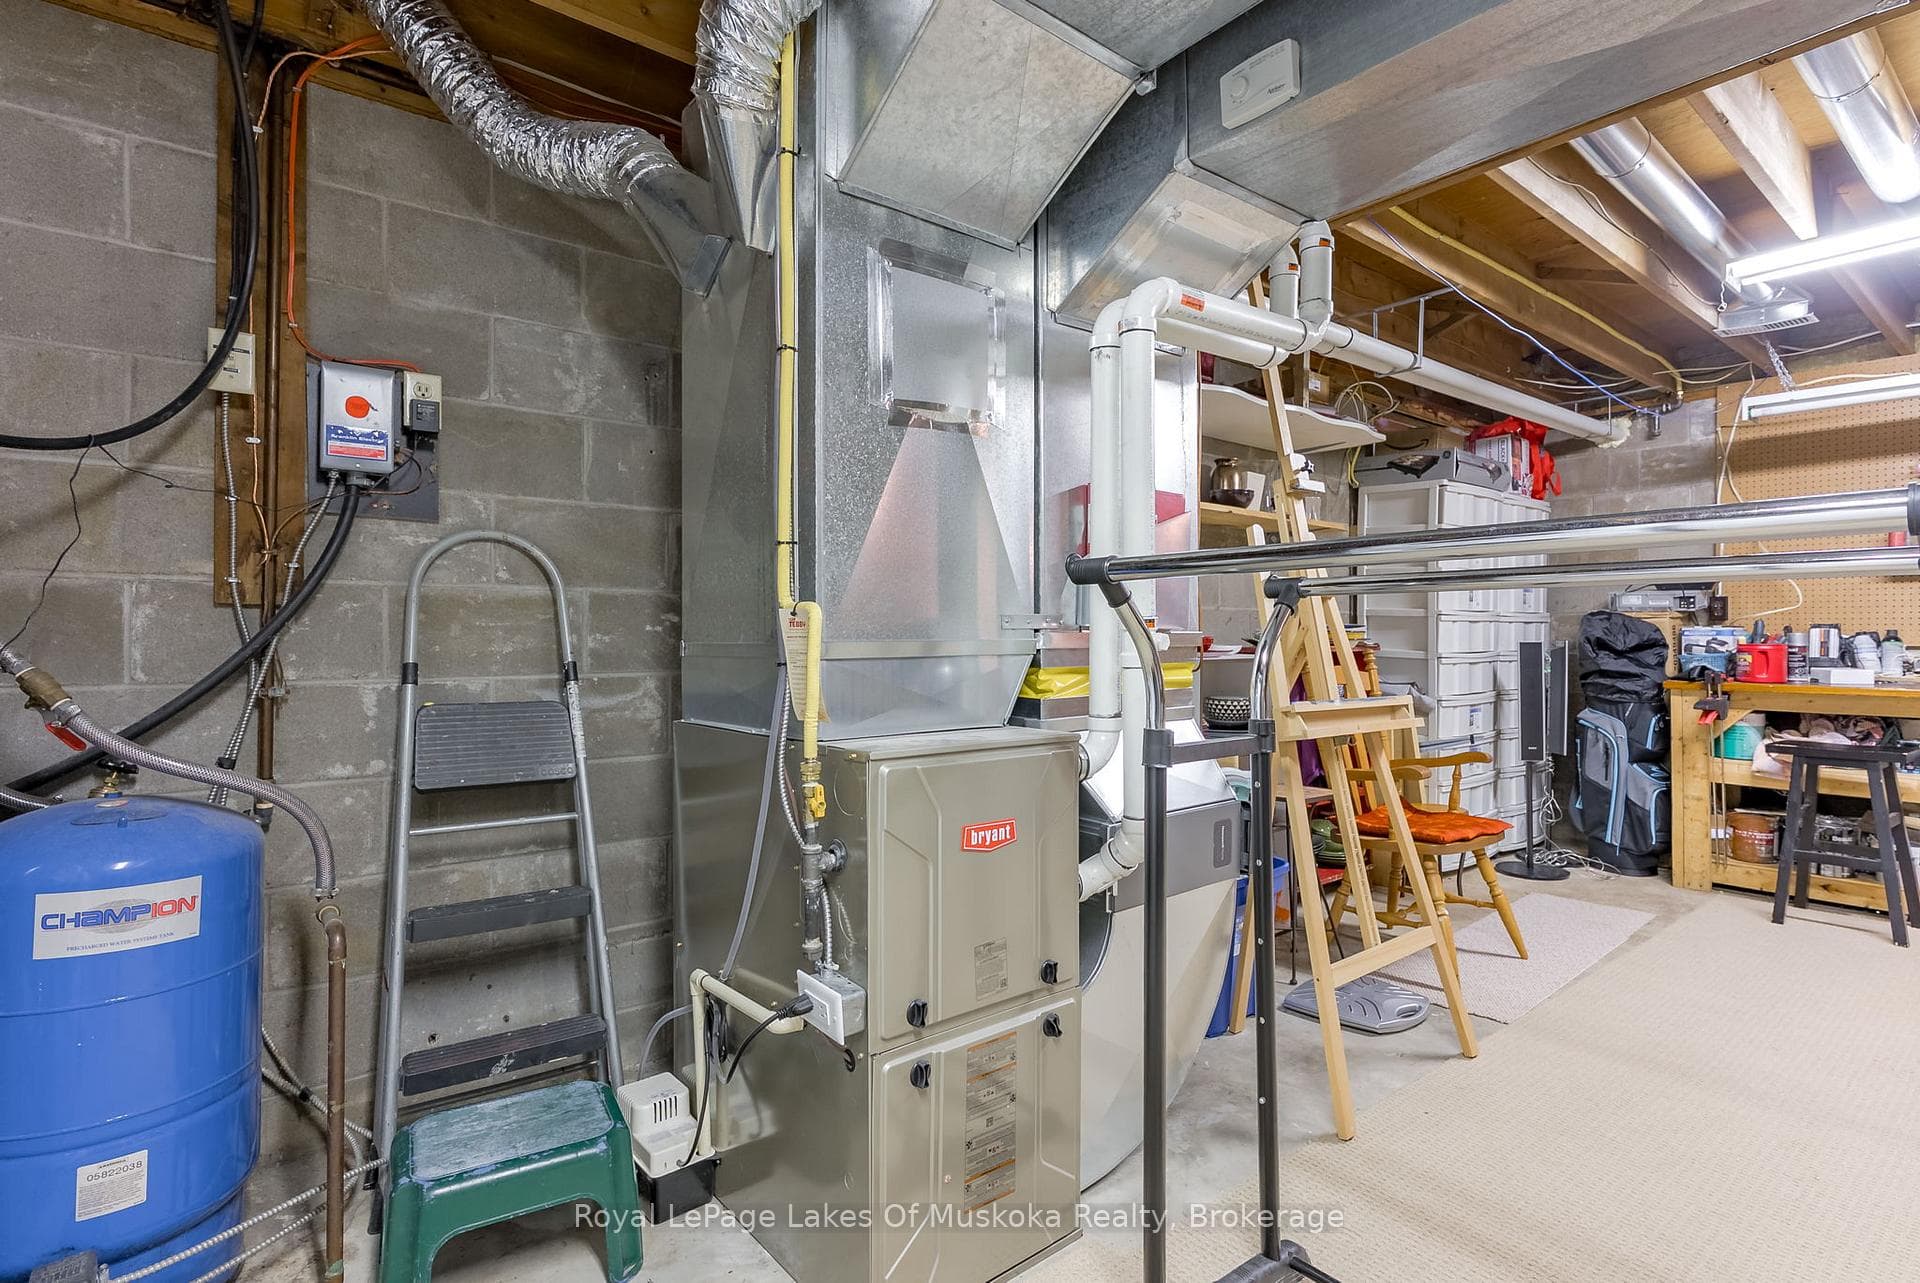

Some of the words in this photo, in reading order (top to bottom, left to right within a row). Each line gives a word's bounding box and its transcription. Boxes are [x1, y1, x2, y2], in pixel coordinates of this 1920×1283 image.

[971, 824, 1011, 846] bryant
[66, 942, 109, 952] PRECHARGED
[109, 938, 131, 947] WATER
[159, 932, 175, 940] TANK
[87, 1160, 143, 1182] 05822038
